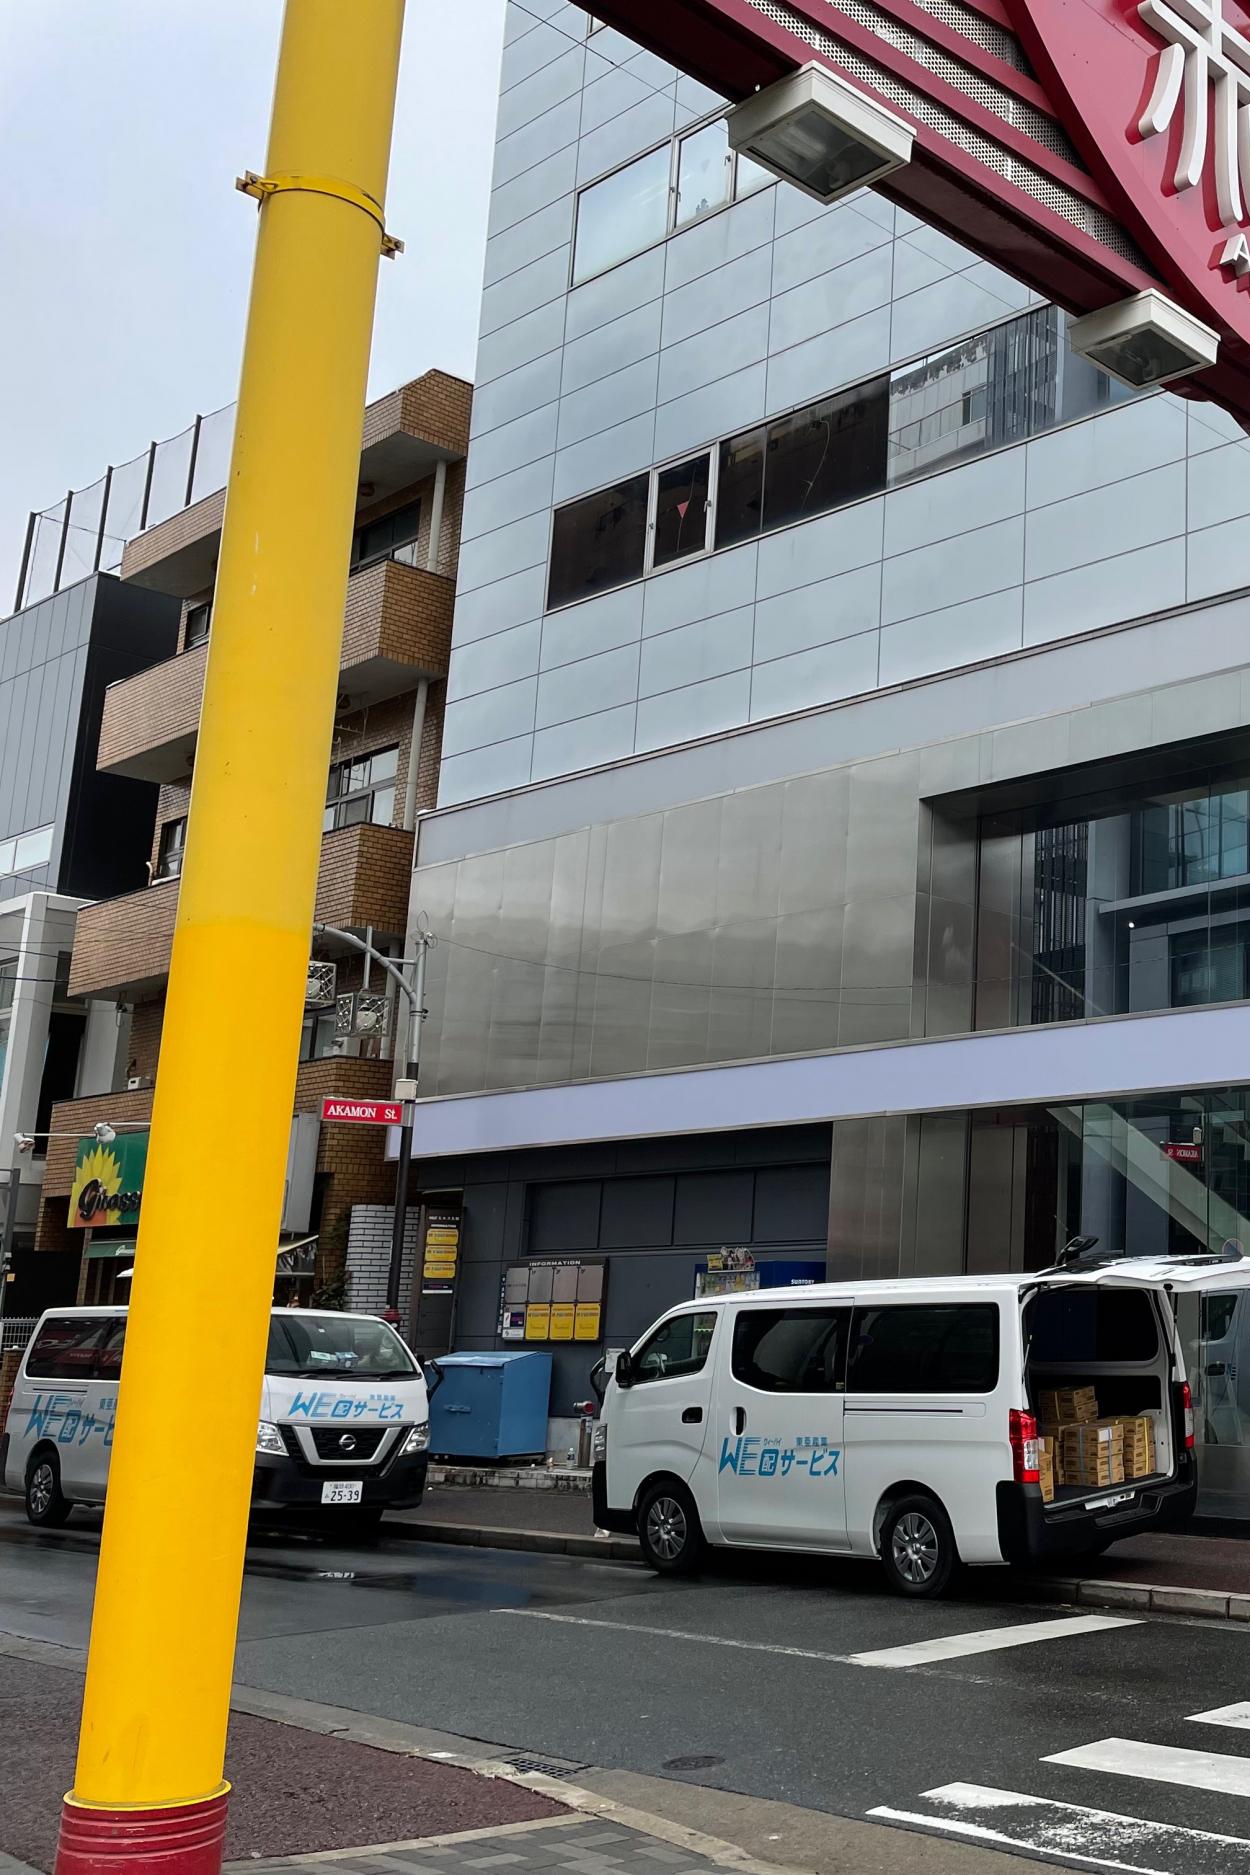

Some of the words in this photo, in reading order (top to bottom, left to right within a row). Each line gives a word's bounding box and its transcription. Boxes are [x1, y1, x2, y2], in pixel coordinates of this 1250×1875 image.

[327, 1104, 377, 1118] AKAMON
[384, 1108, 398, 1119] St.
[331, 1490, 360, 1502] 25-39
